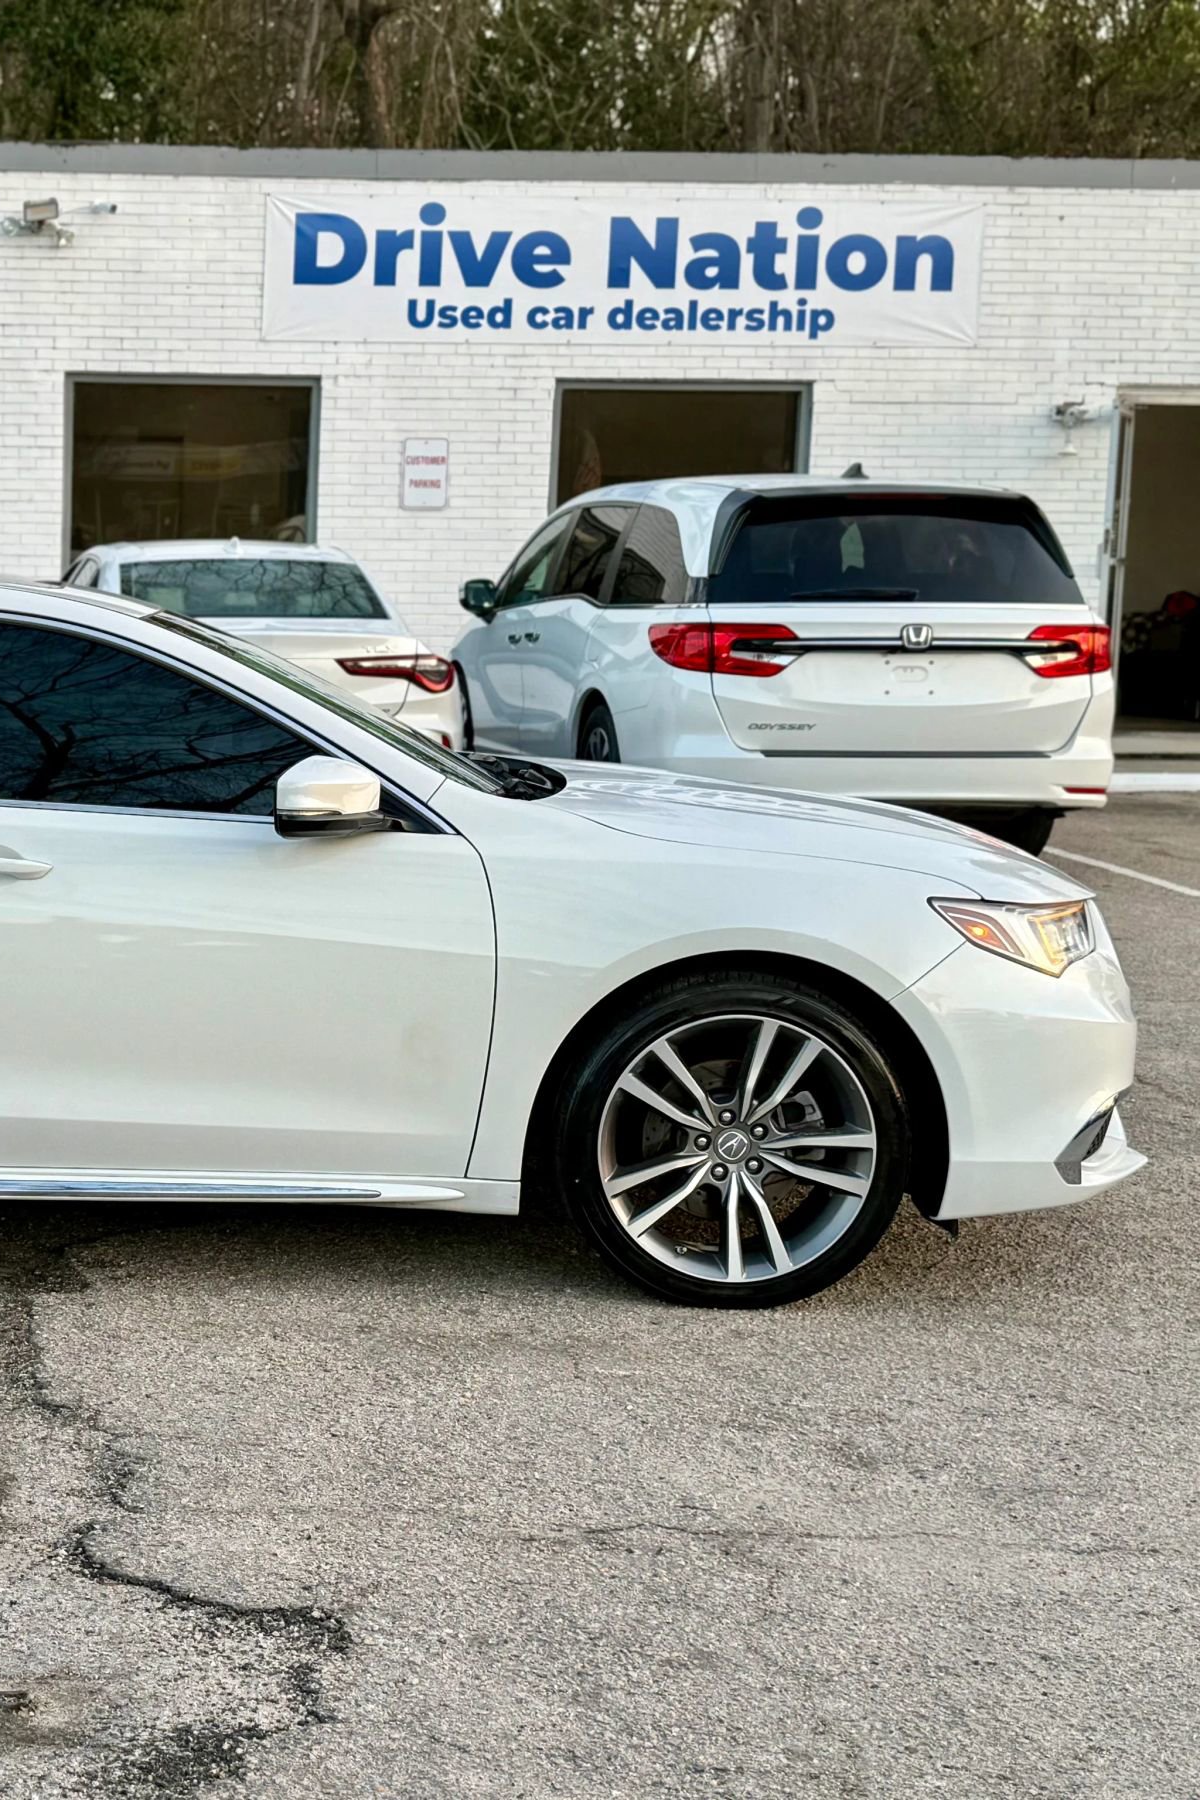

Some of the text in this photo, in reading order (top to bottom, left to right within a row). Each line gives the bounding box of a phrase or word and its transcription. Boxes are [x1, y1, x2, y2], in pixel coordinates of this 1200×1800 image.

[292, 202, 955, 293] Drive Nation
[407, 297, 836, 341] Used car dealership
[406, 455, 448, 465] CUSTOMER
[409, 479, 441, 488] PARKING
[747, 722, 817, 731] ODYSSEY
